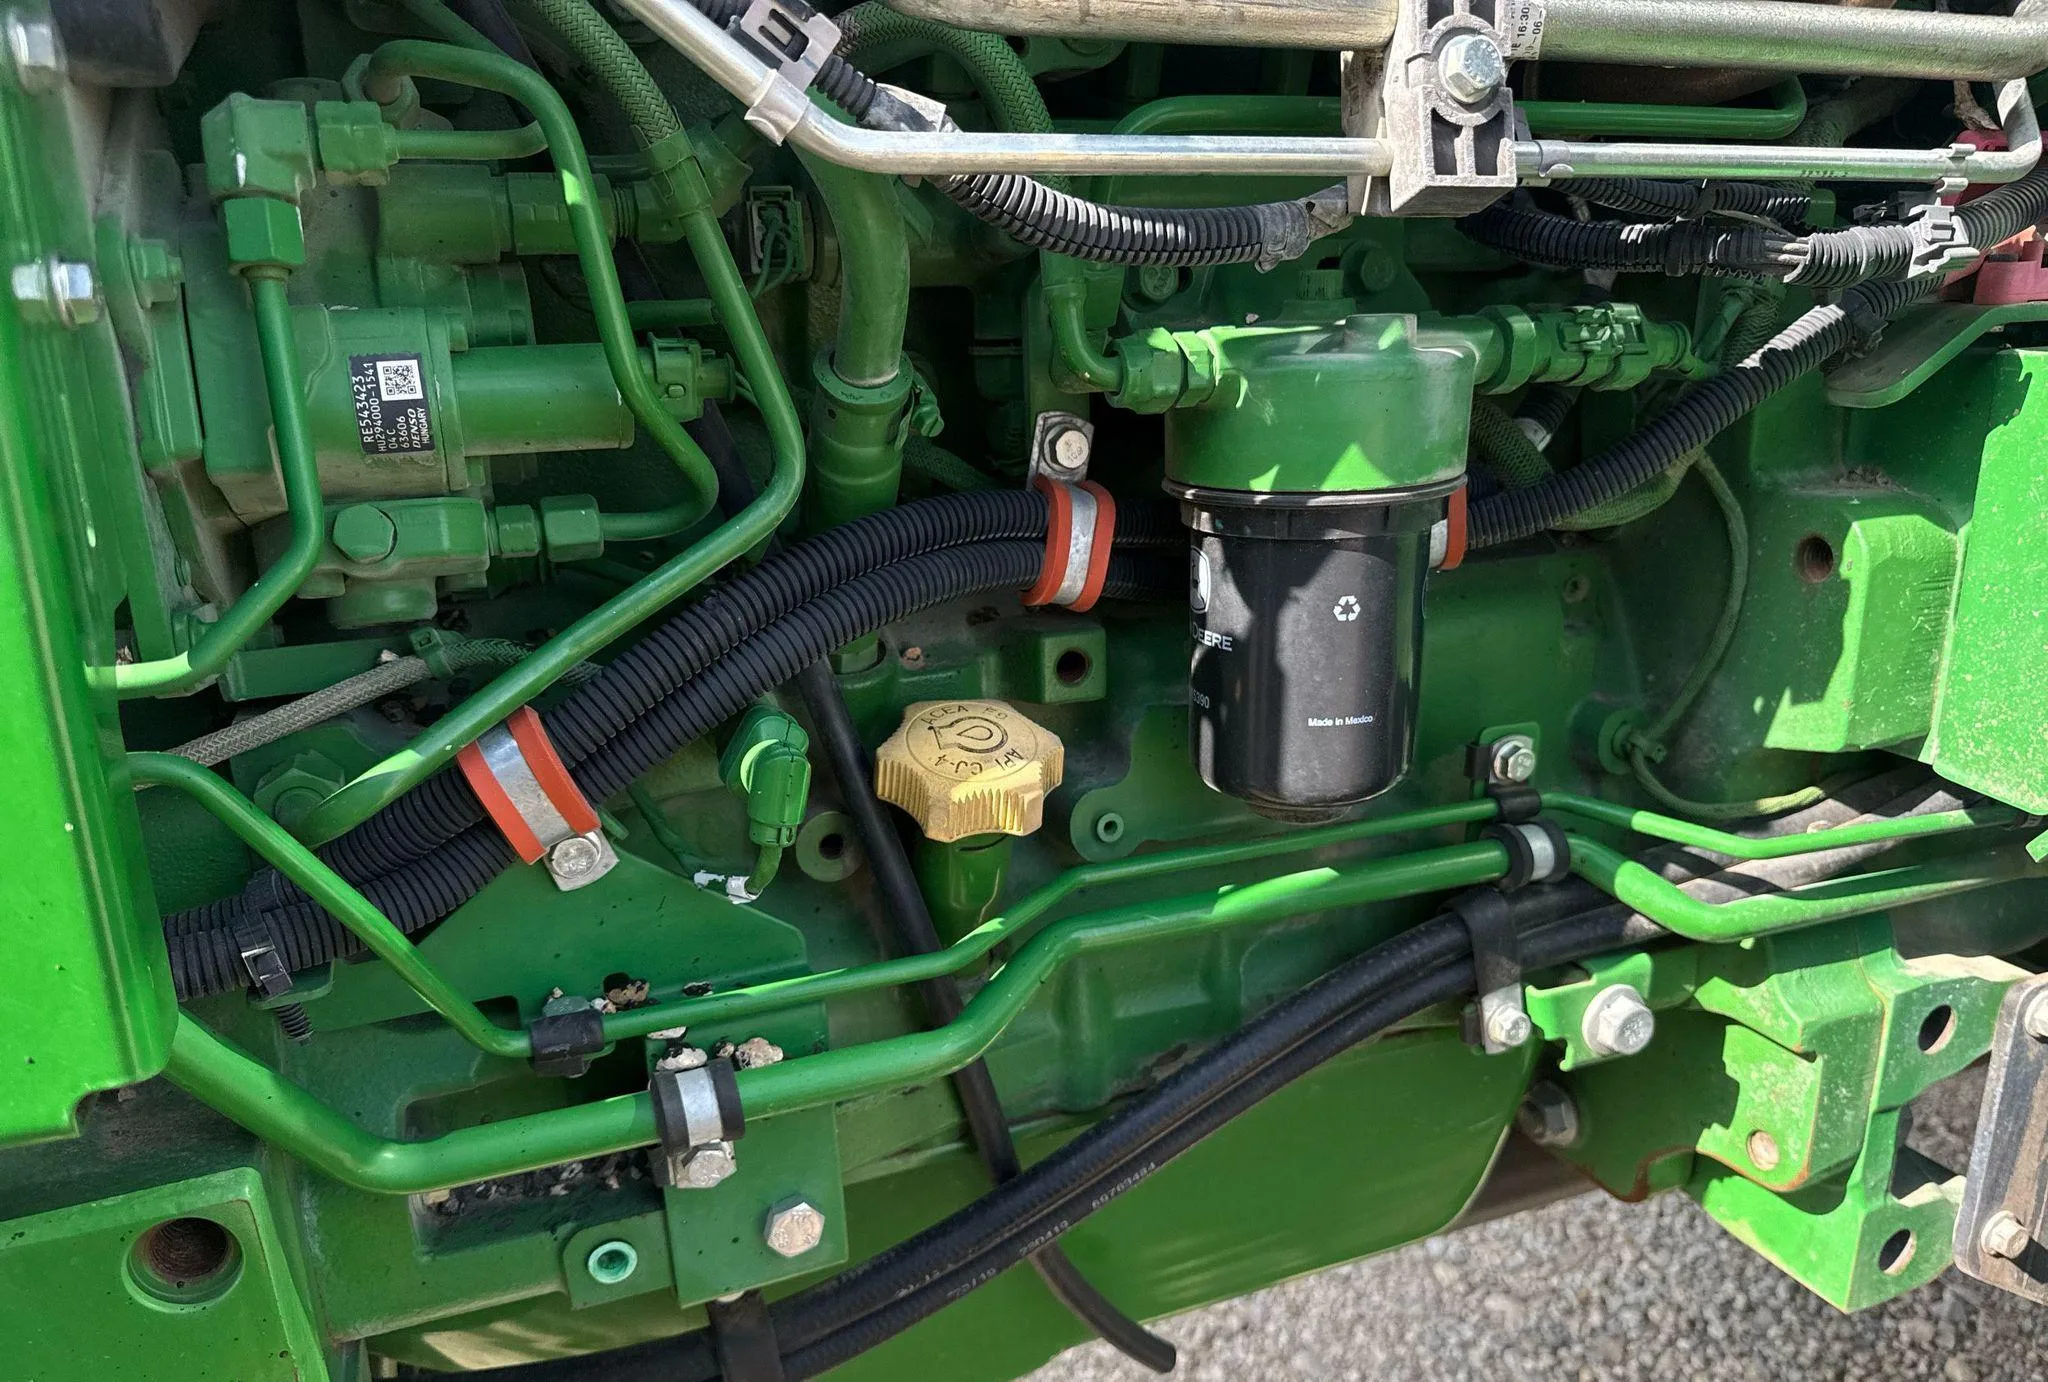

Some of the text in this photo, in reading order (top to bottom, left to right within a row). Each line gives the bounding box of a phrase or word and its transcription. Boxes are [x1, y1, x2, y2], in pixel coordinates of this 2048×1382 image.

[352, 376, 374, 442] RE543423
[363, 363, 387, 451] HU294000-1541
[396, 416, 410, 448] 63606
[407, 408, 421, 448] DENSO
[417, 407, 430, 444] HUNGARY
[1192, 621, 1233, 652] DEERE
[921, 704, 969, 725] ACEA
[1307, 715, 1373, 727] Made in Mexico
[935, 748, 1025, 776] API CJ-4
